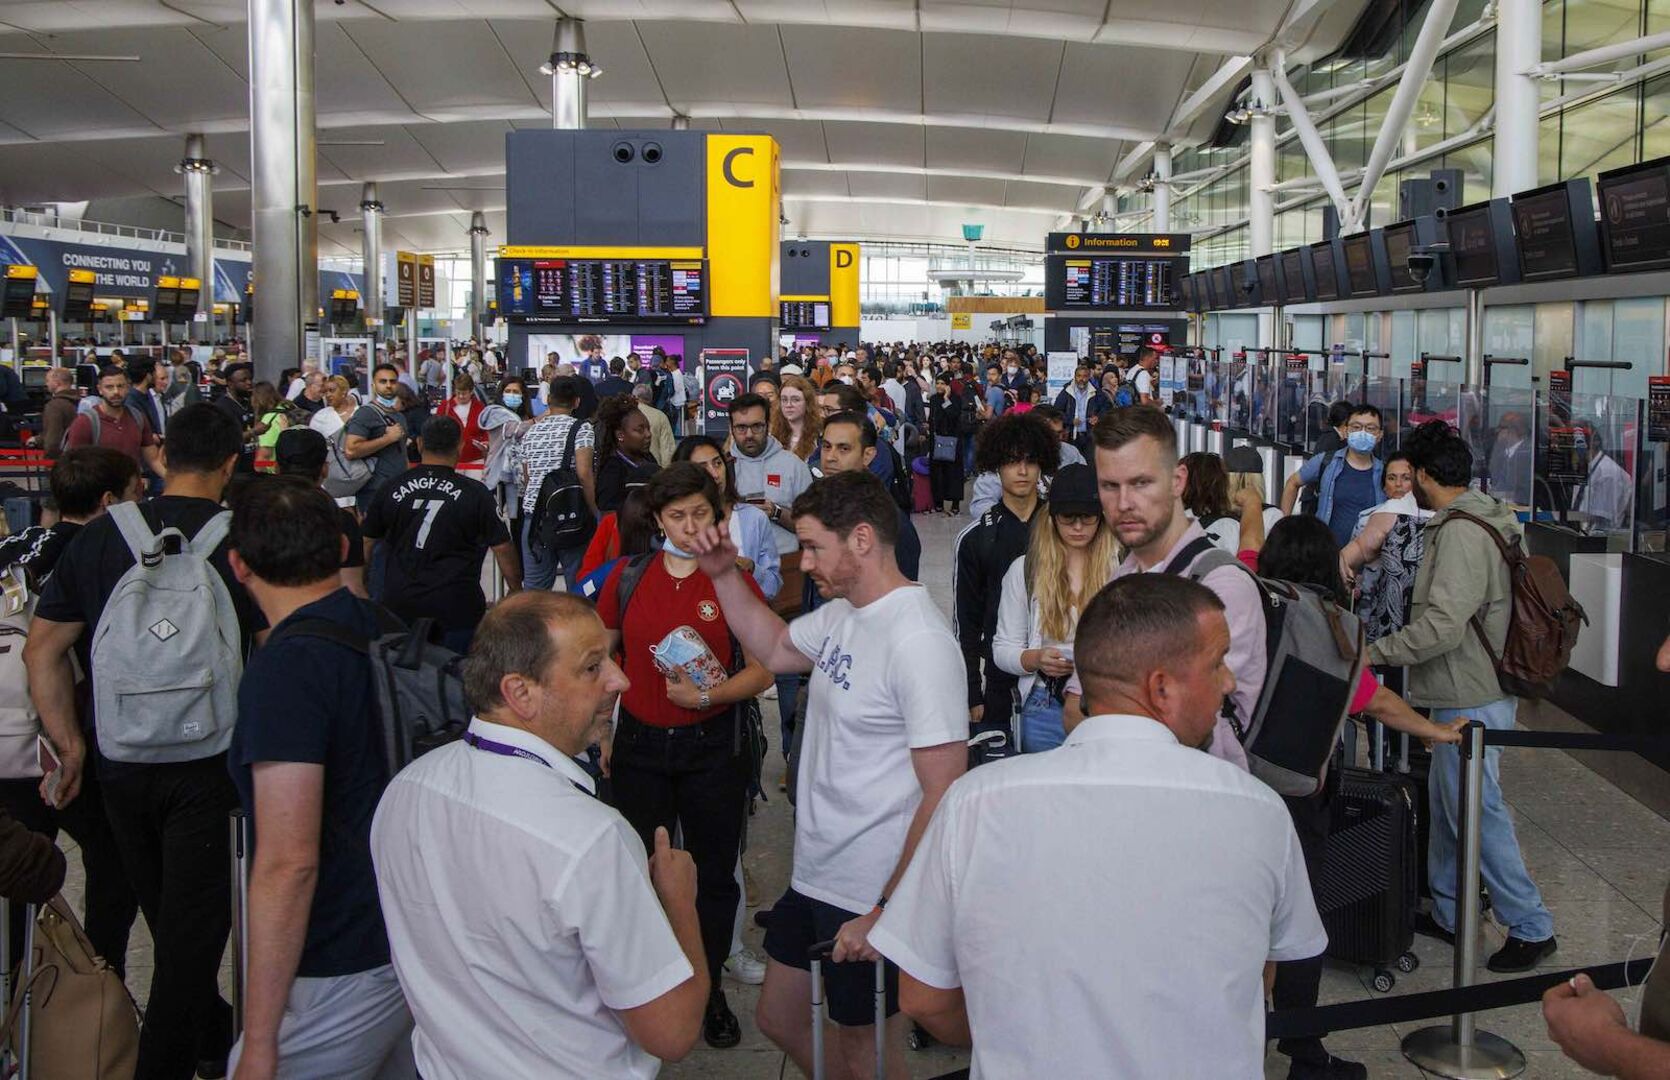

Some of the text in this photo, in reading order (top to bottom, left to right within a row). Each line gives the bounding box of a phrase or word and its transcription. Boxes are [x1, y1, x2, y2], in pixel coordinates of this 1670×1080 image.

[723, 147, 754, 188] C
[1084, 238, 1138, 247] Information
[62, 253, 151, 272] CONNECTING YOU
[836, 250, 853, 268] D
[95, 273, 150, 288] THE WORLD
[412, 499, 445, 550] 7
